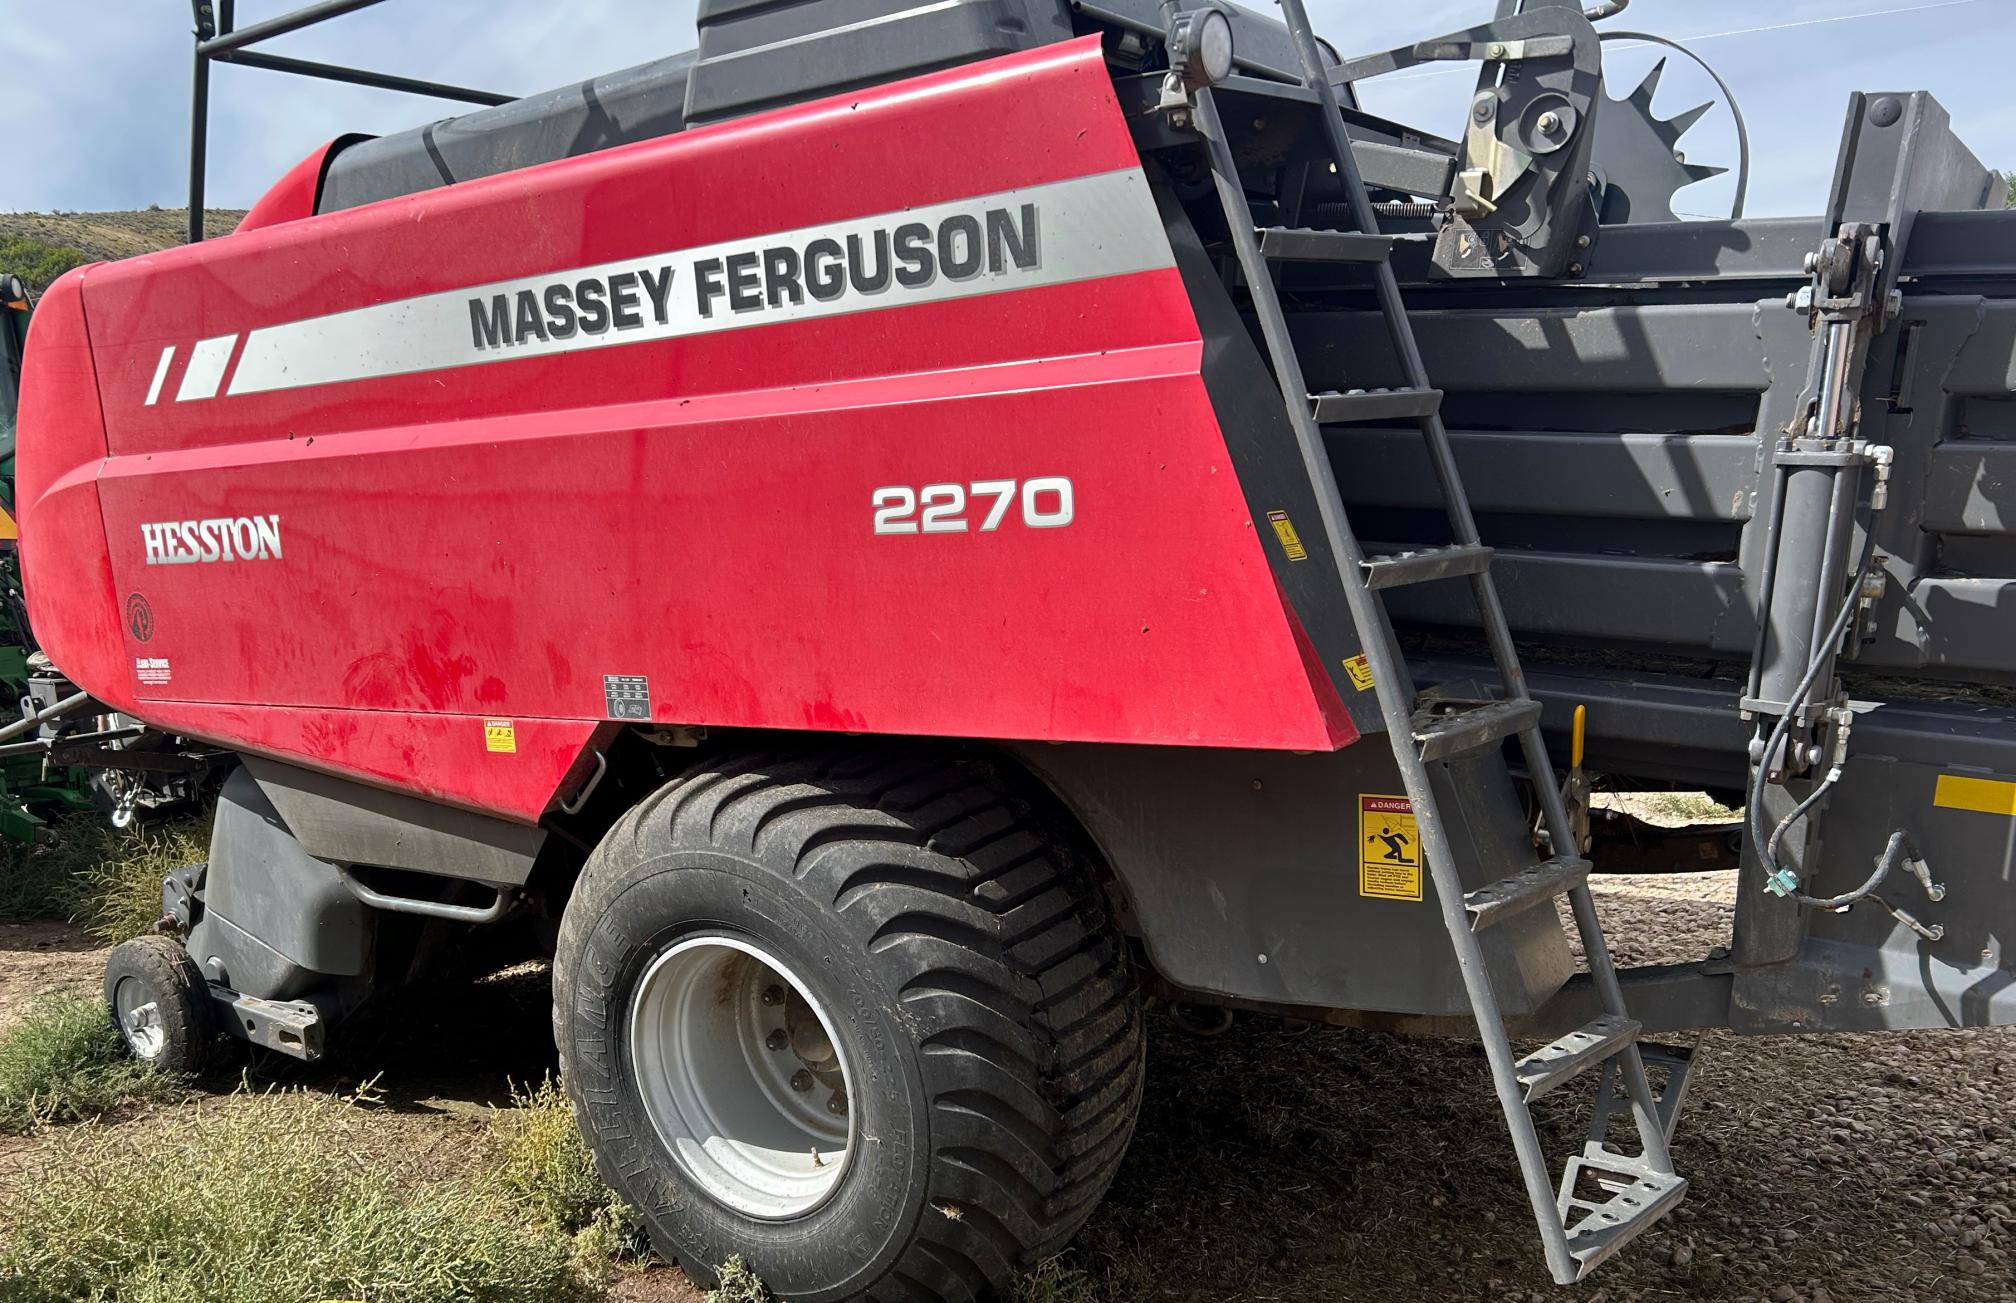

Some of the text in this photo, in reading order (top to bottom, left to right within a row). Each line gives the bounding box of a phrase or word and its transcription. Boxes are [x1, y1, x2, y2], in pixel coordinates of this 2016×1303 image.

[469, 203, 1040, 348] MASSEY FERGUSON
[872, 476, 1075, 535] 2270
[141, 514, 282, 565] HESSTON
[1377, 801, 1411, 810] DANGER
